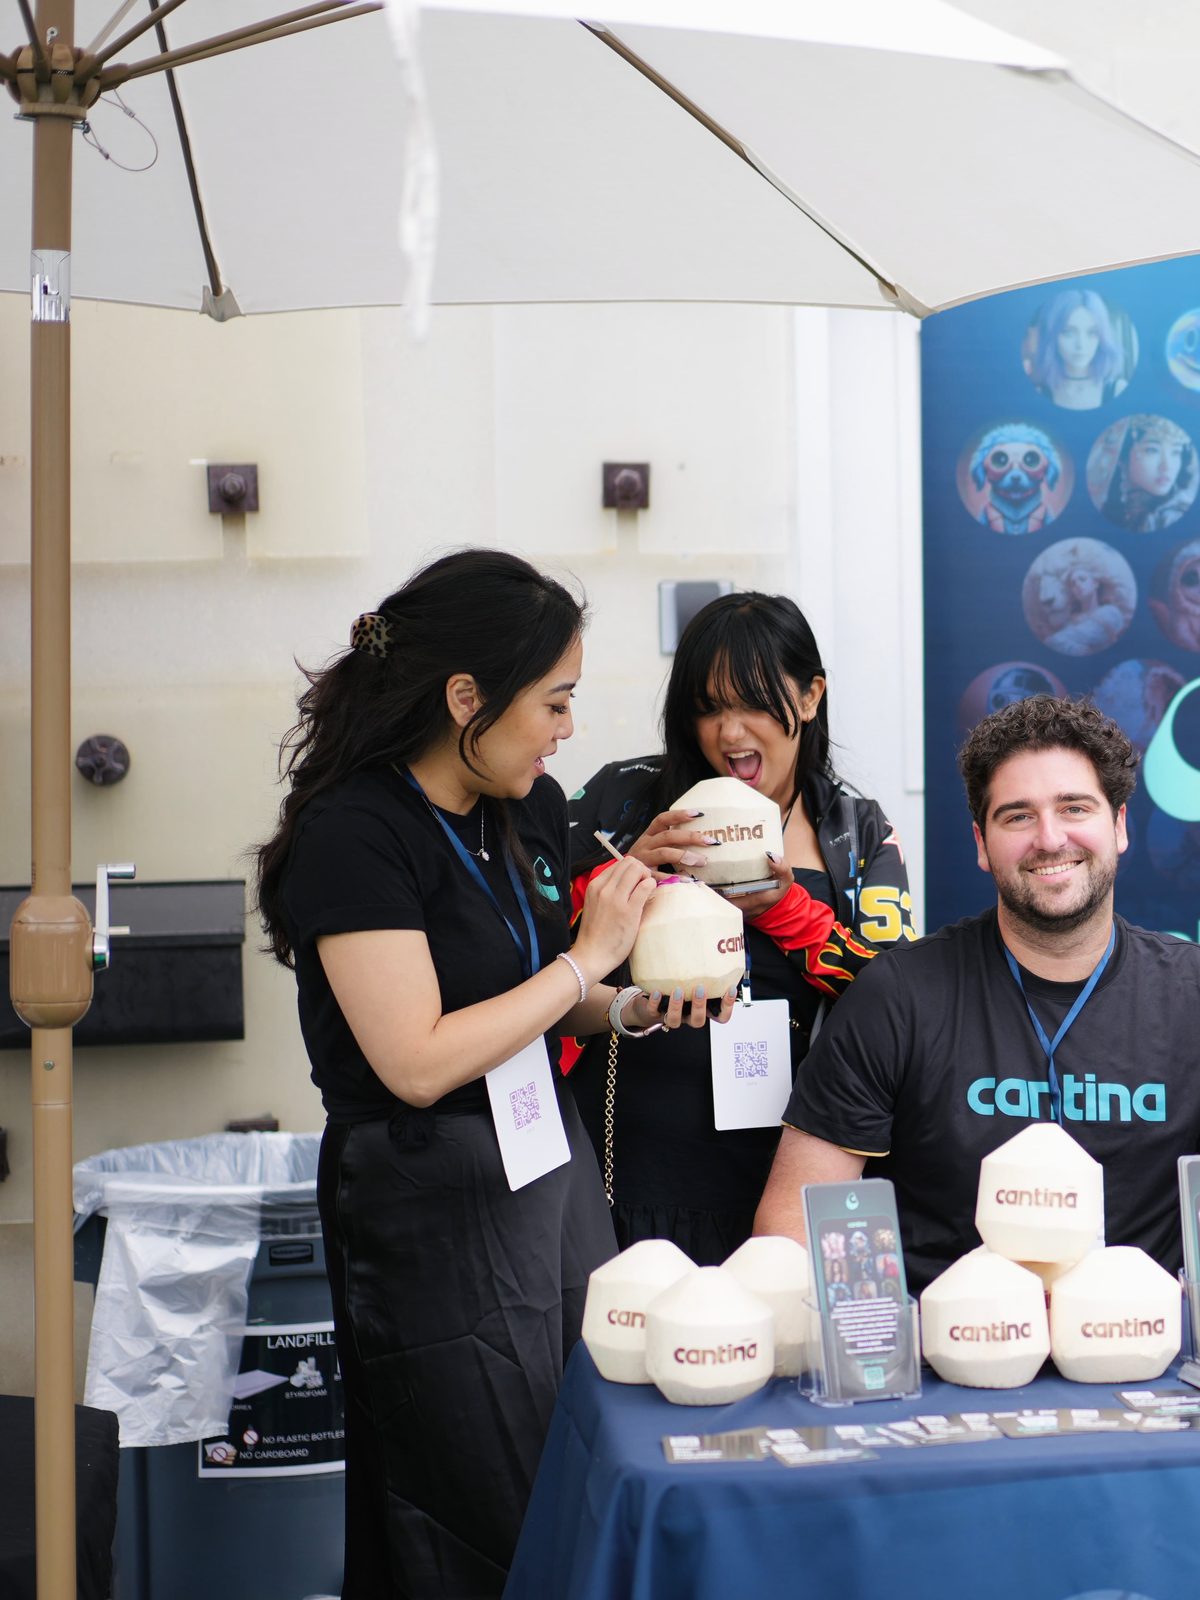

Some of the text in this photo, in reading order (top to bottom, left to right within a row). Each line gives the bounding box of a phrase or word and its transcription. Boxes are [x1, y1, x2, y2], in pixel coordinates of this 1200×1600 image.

[967, 1073, 1166, 1122] cantina
[995, 1187, 1078, 1209] cantina
[1081, 1318, 1165, 1338] cantina
[267, 1332, 336, 1349] LANDFILL
[673, 1343, 758, 1365] cantina
[262, 1436, 275, 1444] NO
[276, 1433, 310, 1444] PLASTIC
[240, 1448, 309, 1460] NO CARDBOARD
